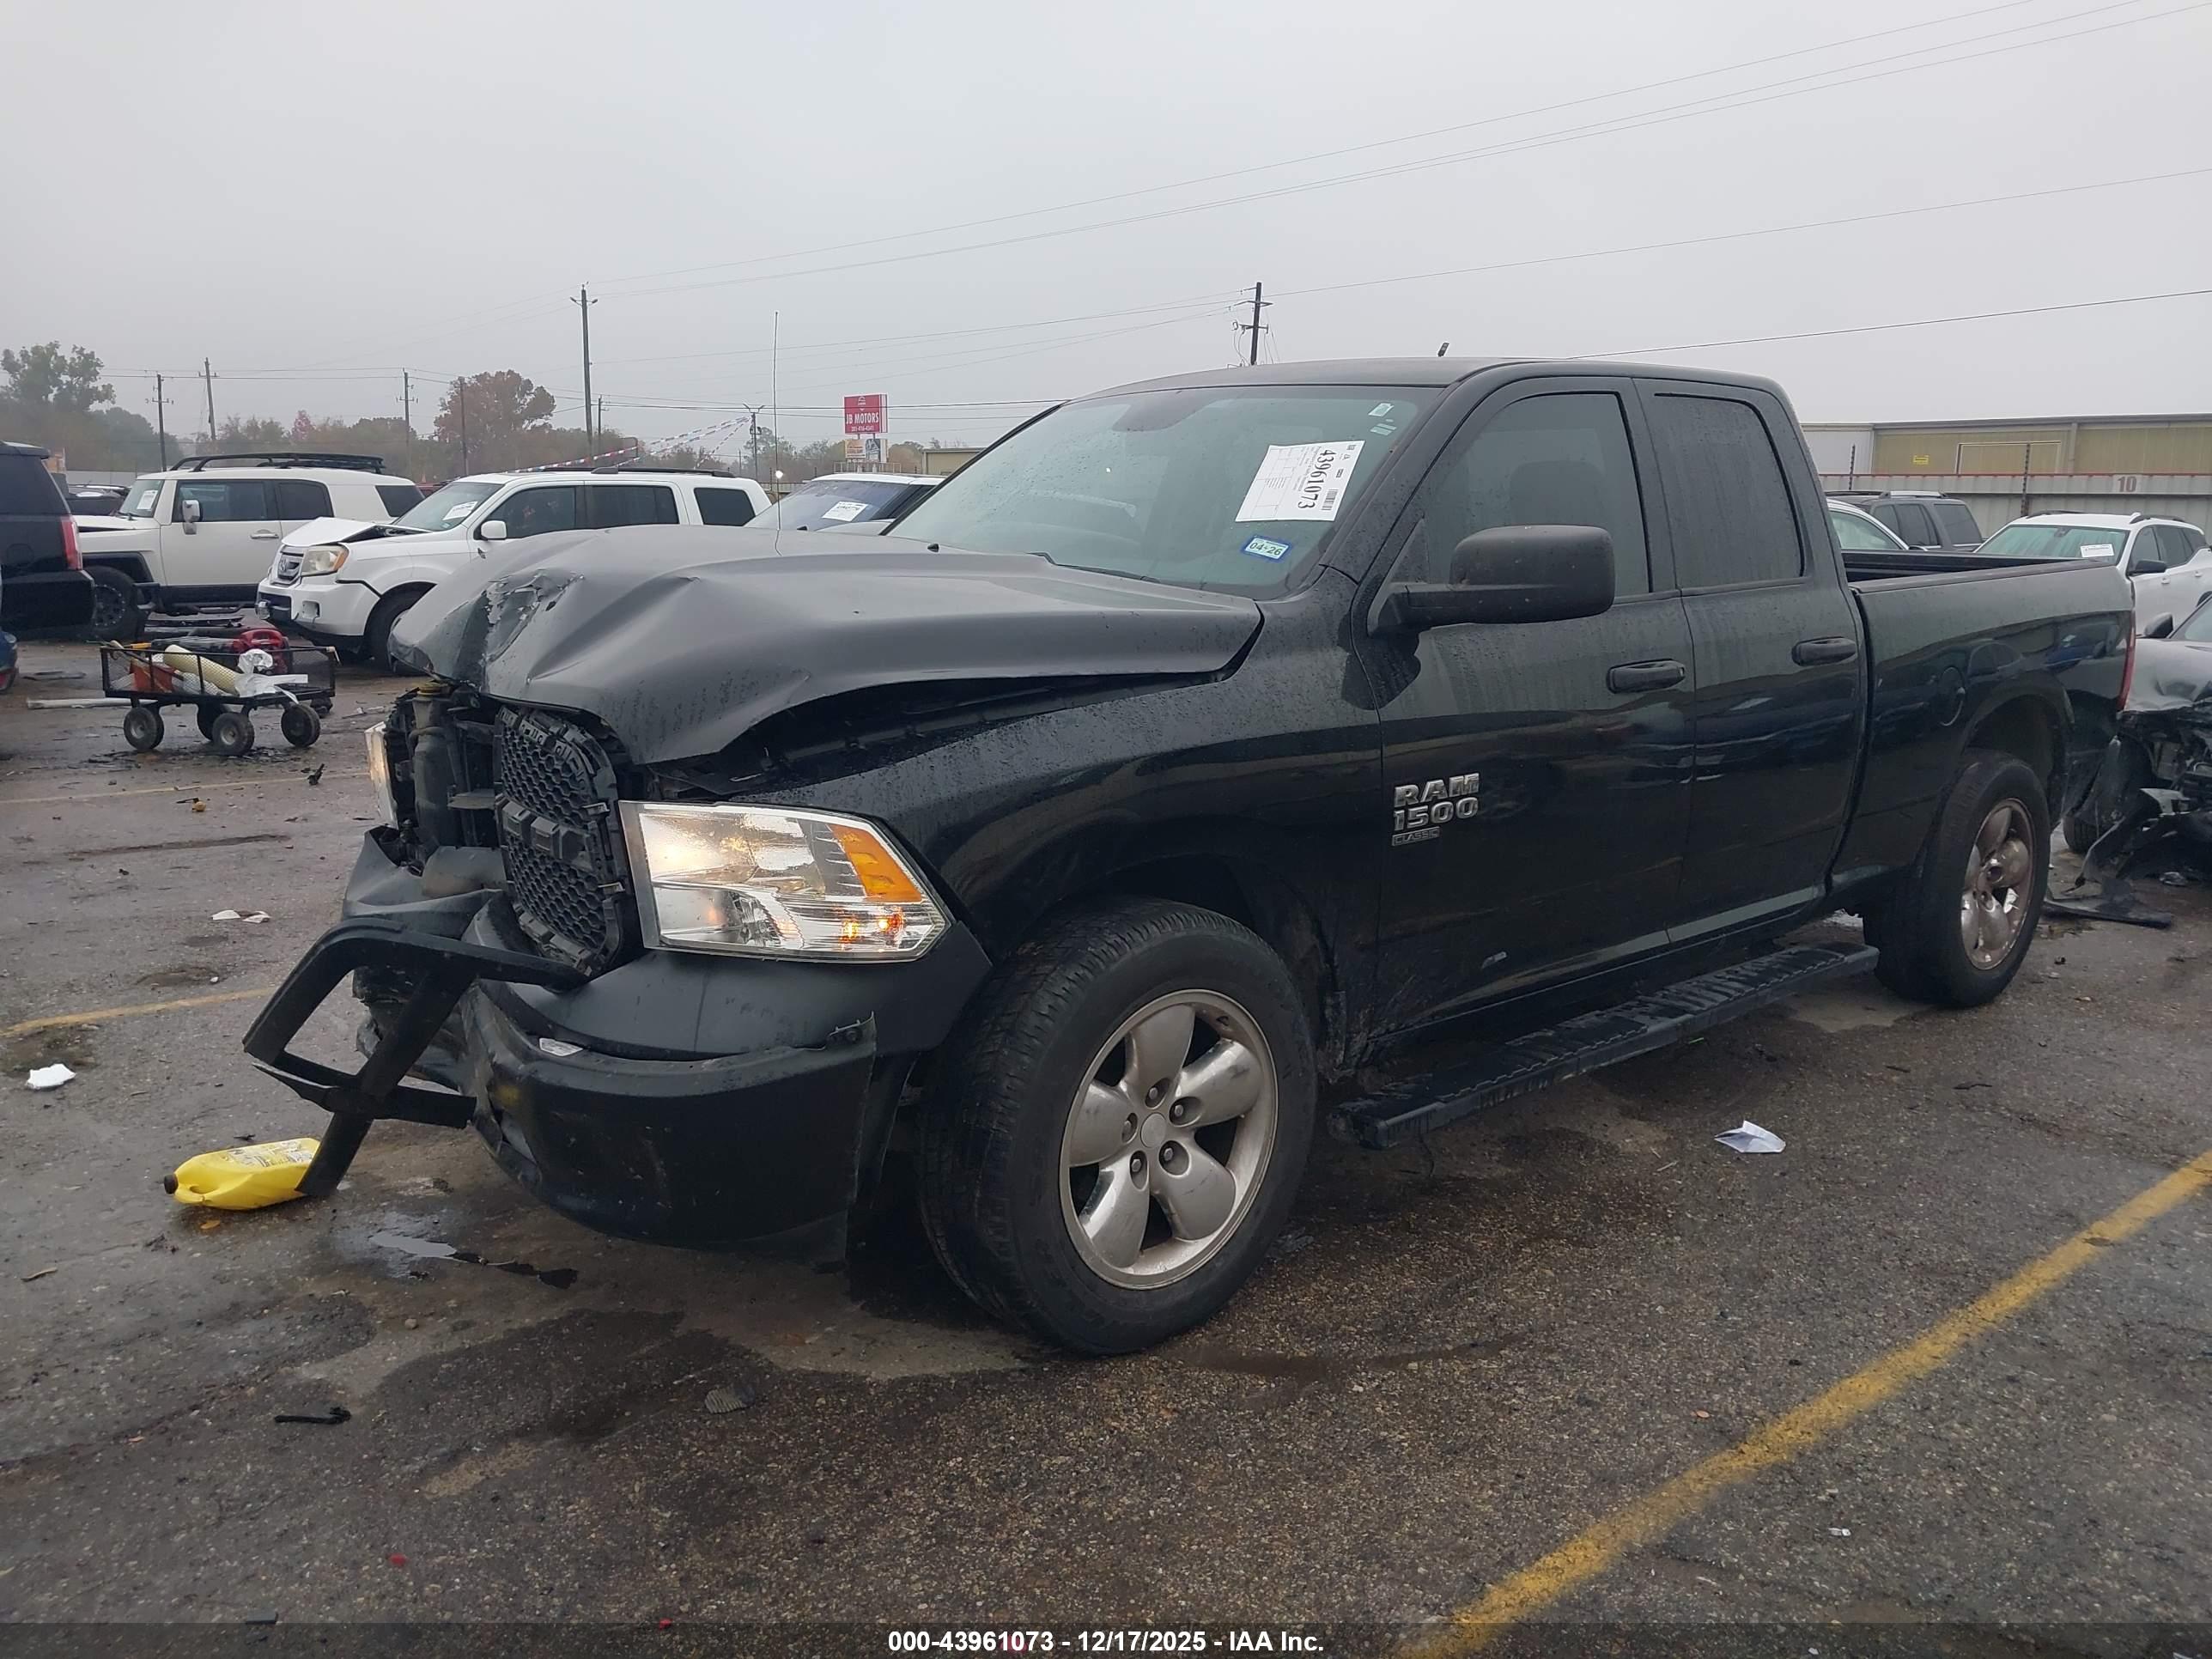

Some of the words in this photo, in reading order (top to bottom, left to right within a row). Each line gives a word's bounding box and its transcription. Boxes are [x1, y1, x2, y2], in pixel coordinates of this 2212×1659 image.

[846, 413, 853, 424] JB
[854, 412, 879, 424] MOTORS
[1297, 449, 1337, 508] 43961073
[2118, 476, 2136, 492] 10
[1395, 773, 1480, 807] RAM
[1394, 797, 1479, 830] 1500
